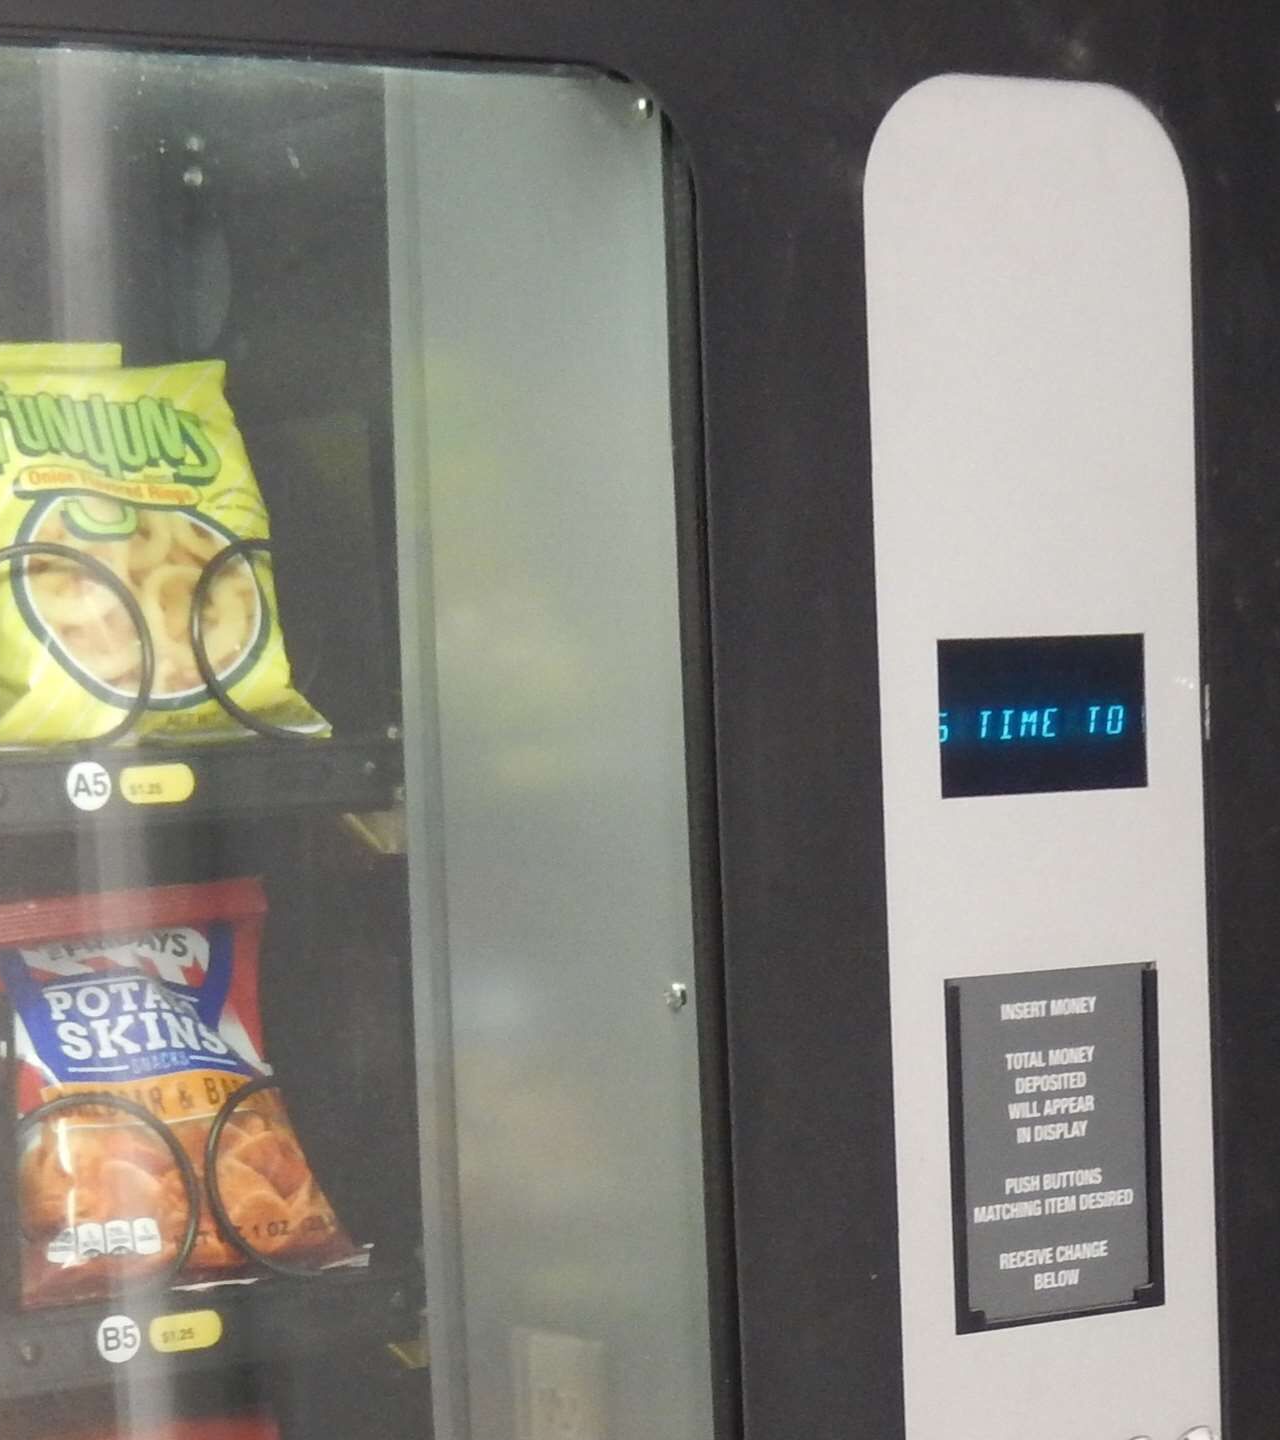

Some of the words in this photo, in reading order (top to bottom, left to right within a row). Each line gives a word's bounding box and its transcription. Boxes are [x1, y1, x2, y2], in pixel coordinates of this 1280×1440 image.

[979, 707, 1059, 740] TIME
[1088, 704, 1125, 735] TO
[73, 771, 107, 799] A5
[1000, 1000, 1047, 1021] INSERT
[1050, 996, 1097, 1017] MONEY
[57, 1012, 228, 1061] SKINS
[1005, 1051, 1046, 1071] TOTAL
[1048, 1045, 1095, 1065] MONEY
[1015, 1071, 1087, 1095] DEPOSITED
[1008, 1100, 1041, 1120] WILL
[1043, 1095, 1095, 1117] APPEAR
[1016, 1126, 1031, 1144] IN
[1034, 1120, 1088, 1143] DISPLAY
[1005, 1174, 1040, 1195] PUSH
[1043, 1167, 1103, 1191] BUTTONS
[974, 1200, 1042, 1224] MATCHING
[1045, 1195, 1076, 1216] ITEM
[1079, 1188, 1134, 1211] DESIRED
[999, 1247, 1054, 1270] RECEIVE
[1055, 1240, 1109, 1263] CHANGE
[1033, 1268, 1080, 1291] BELOW
[103, 1322, 138, 1352] B5
